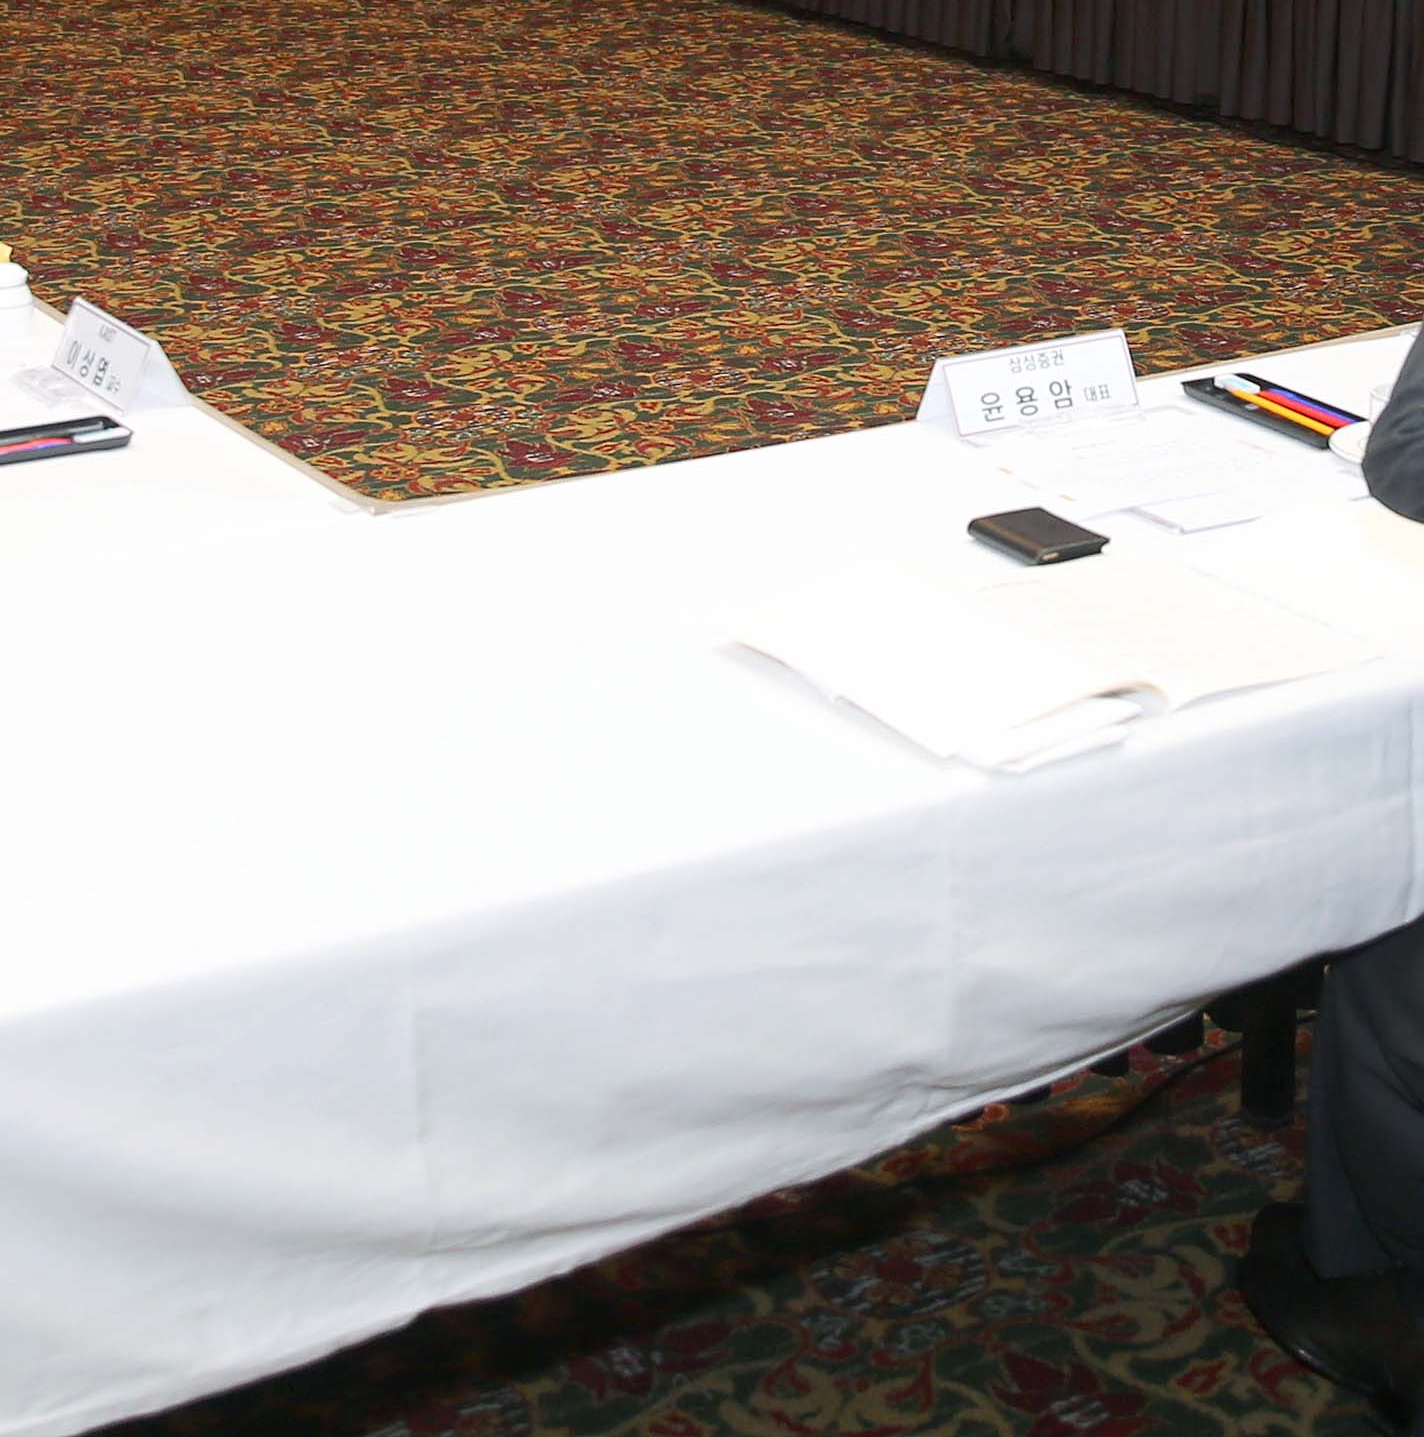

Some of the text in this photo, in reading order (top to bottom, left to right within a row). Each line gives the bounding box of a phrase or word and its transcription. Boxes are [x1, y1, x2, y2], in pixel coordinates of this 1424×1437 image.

[1008, 348, 1065, 375] 삼성증권
[981, 379, 1112, 423] 윤용암 대표
